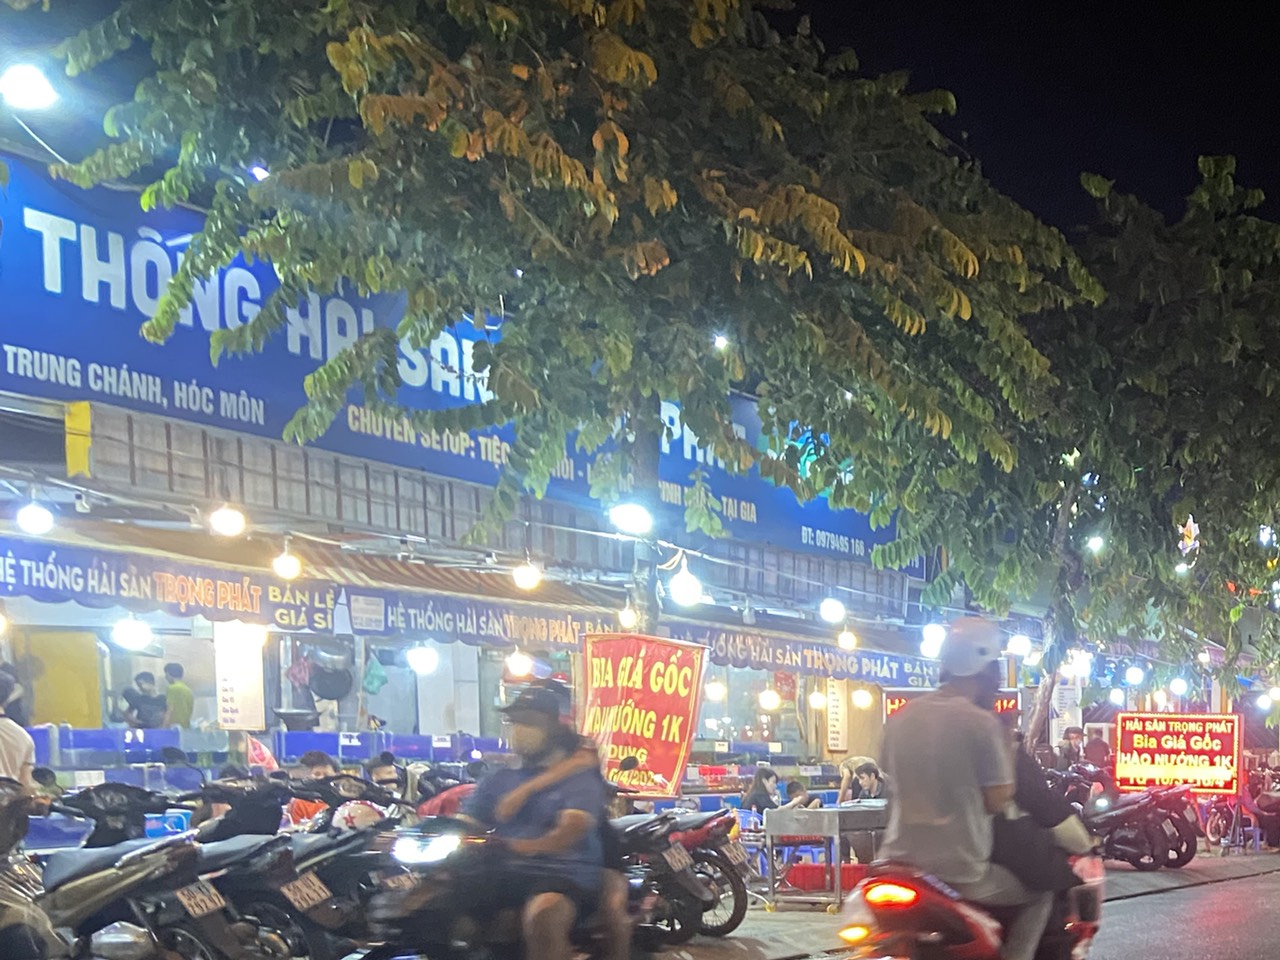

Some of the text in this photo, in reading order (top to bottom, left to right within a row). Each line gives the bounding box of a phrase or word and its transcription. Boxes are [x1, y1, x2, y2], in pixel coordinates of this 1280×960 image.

[3, 343, 265, 425] TRUNG CHÁNH, HÓC MÔN
[722, 495, 738, 522] TẠI
[740, 501, 757, 524] GIA
[152, 571, 215, 613] TRỌNG
[217, 576, 262, 614] PHÁT
[387, 600, 406, 634] HỆ
[407, 600, 453, 632] THỐNG
[549, 615, 581, 645] PHÁT
[592, 648, 692, 698] BIA GIÁ GỐC
[803, 648, 859, 675] TRỌNG
[861, 656, 899, 679] PHÁT
[661, 714, 684, 744] 1K
[1133, 733, 1157, 749] Bia
[1161, 734, 1187, 750] Giá
[1168, 721, 1203, 734] TRỌNG
[1205, 720, 1233, 733] PHÁT
[1213, 755, 1233, 770] 1K
